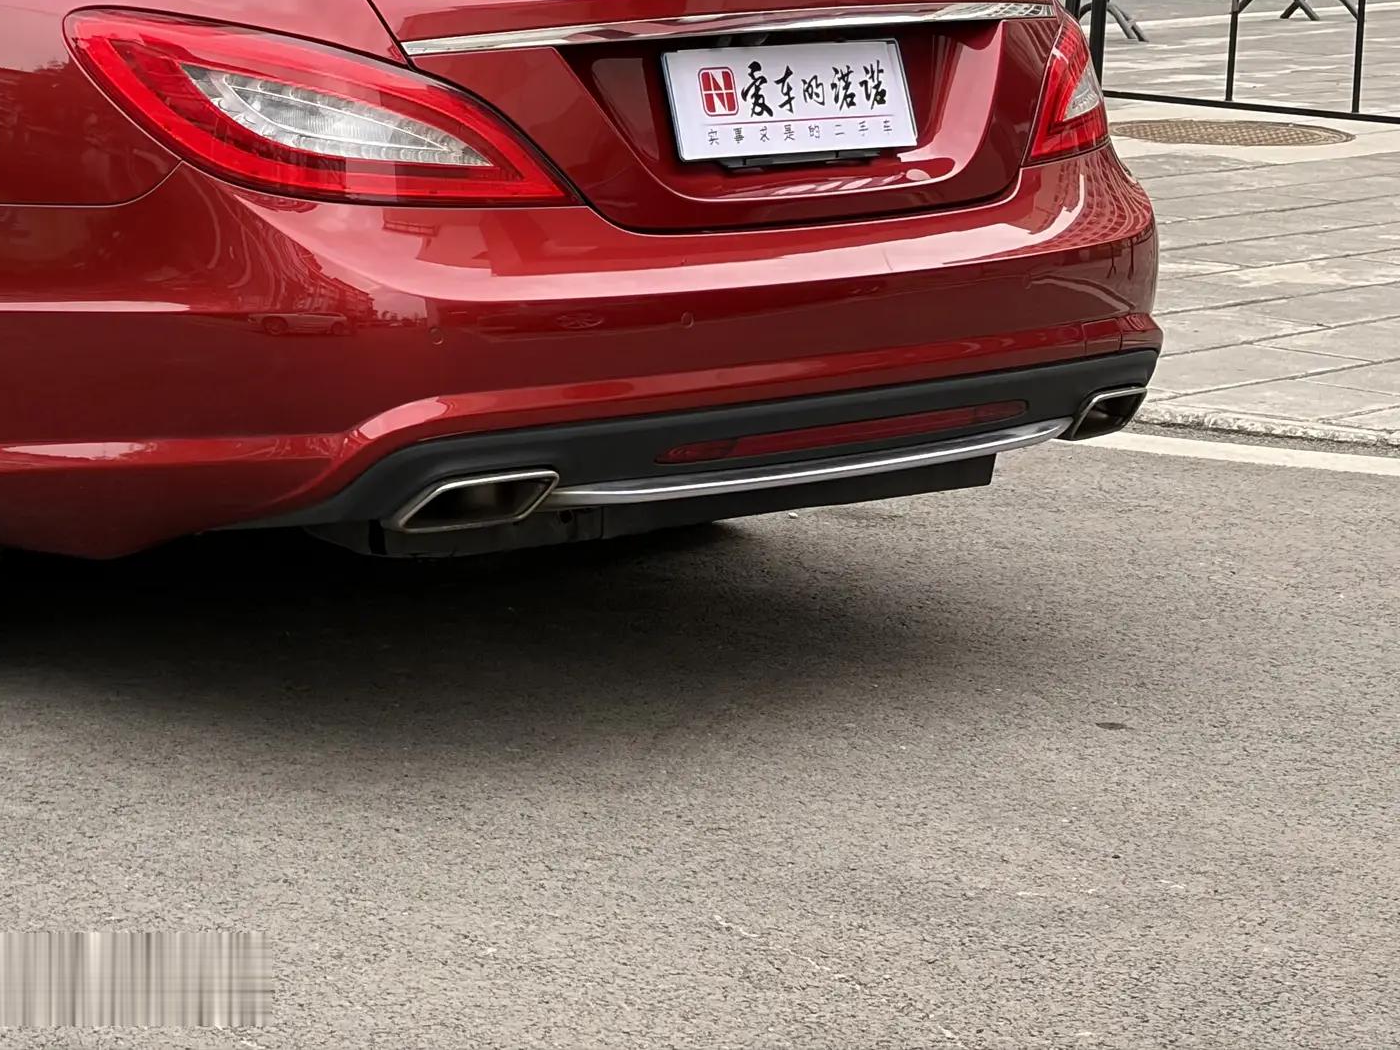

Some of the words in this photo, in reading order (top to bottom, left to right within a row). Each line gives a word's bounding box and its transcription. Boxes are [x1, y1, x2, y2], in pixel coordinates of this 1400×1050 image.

[741, 60, 888, 118] 爱车的诺诺
